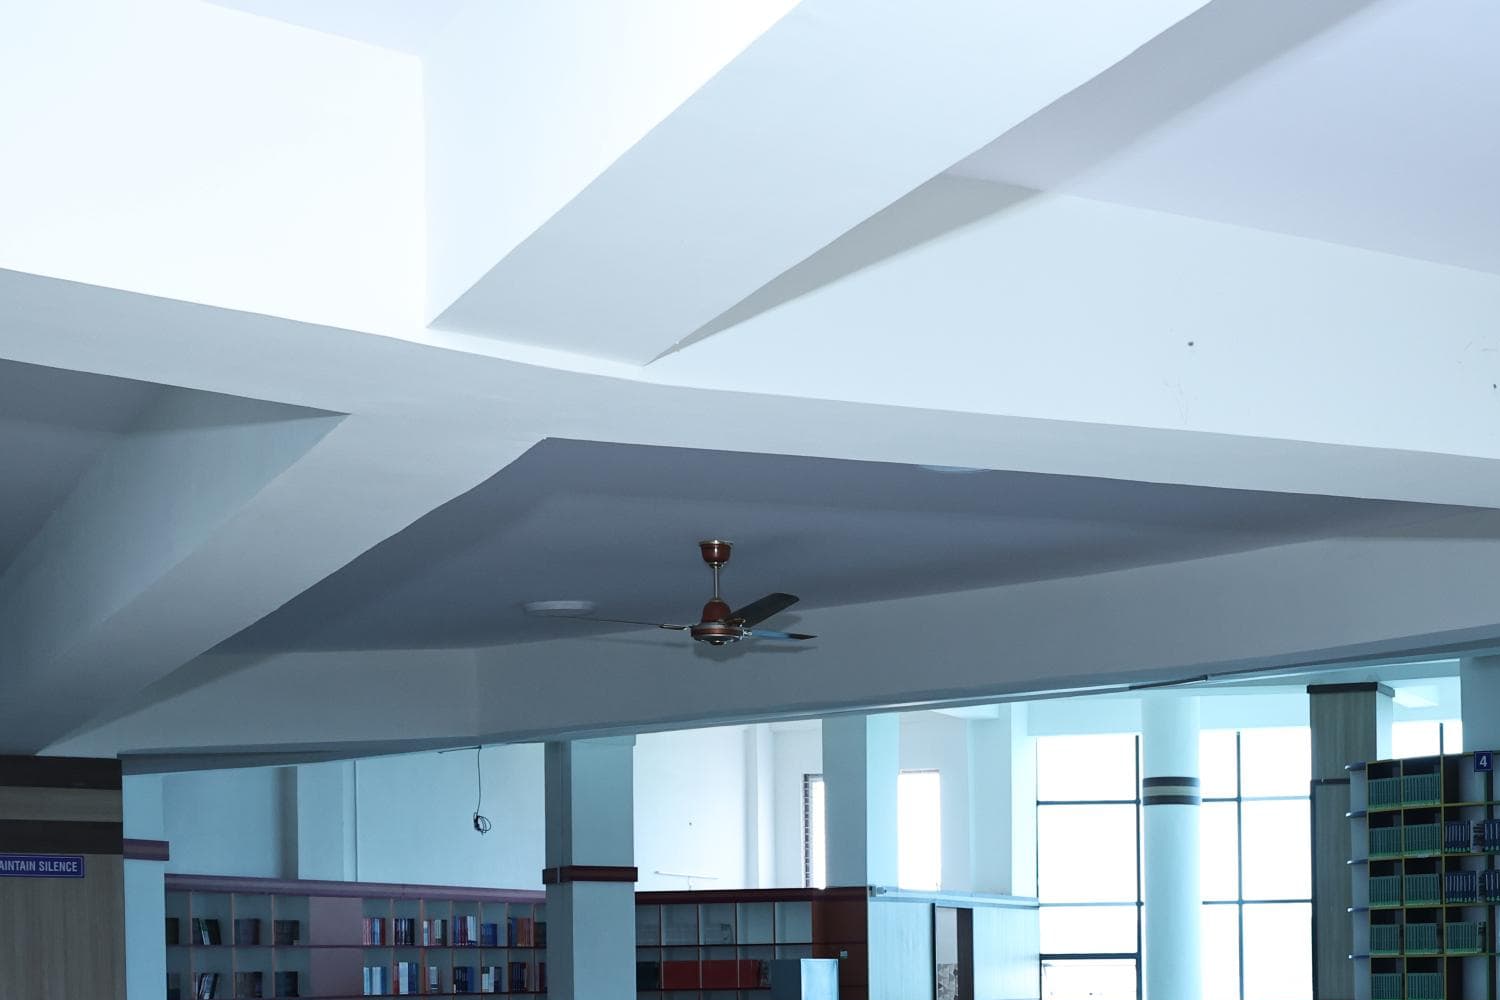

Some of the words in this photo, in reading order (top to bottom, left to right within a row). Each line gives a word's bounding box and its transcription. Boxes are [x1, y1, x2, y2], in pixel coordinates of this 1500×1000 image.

[1480, 755, 1488, 767] 4
[0, 860, 36, 872] AINTAIN
[39, 861, 78, 872] SILENCE
